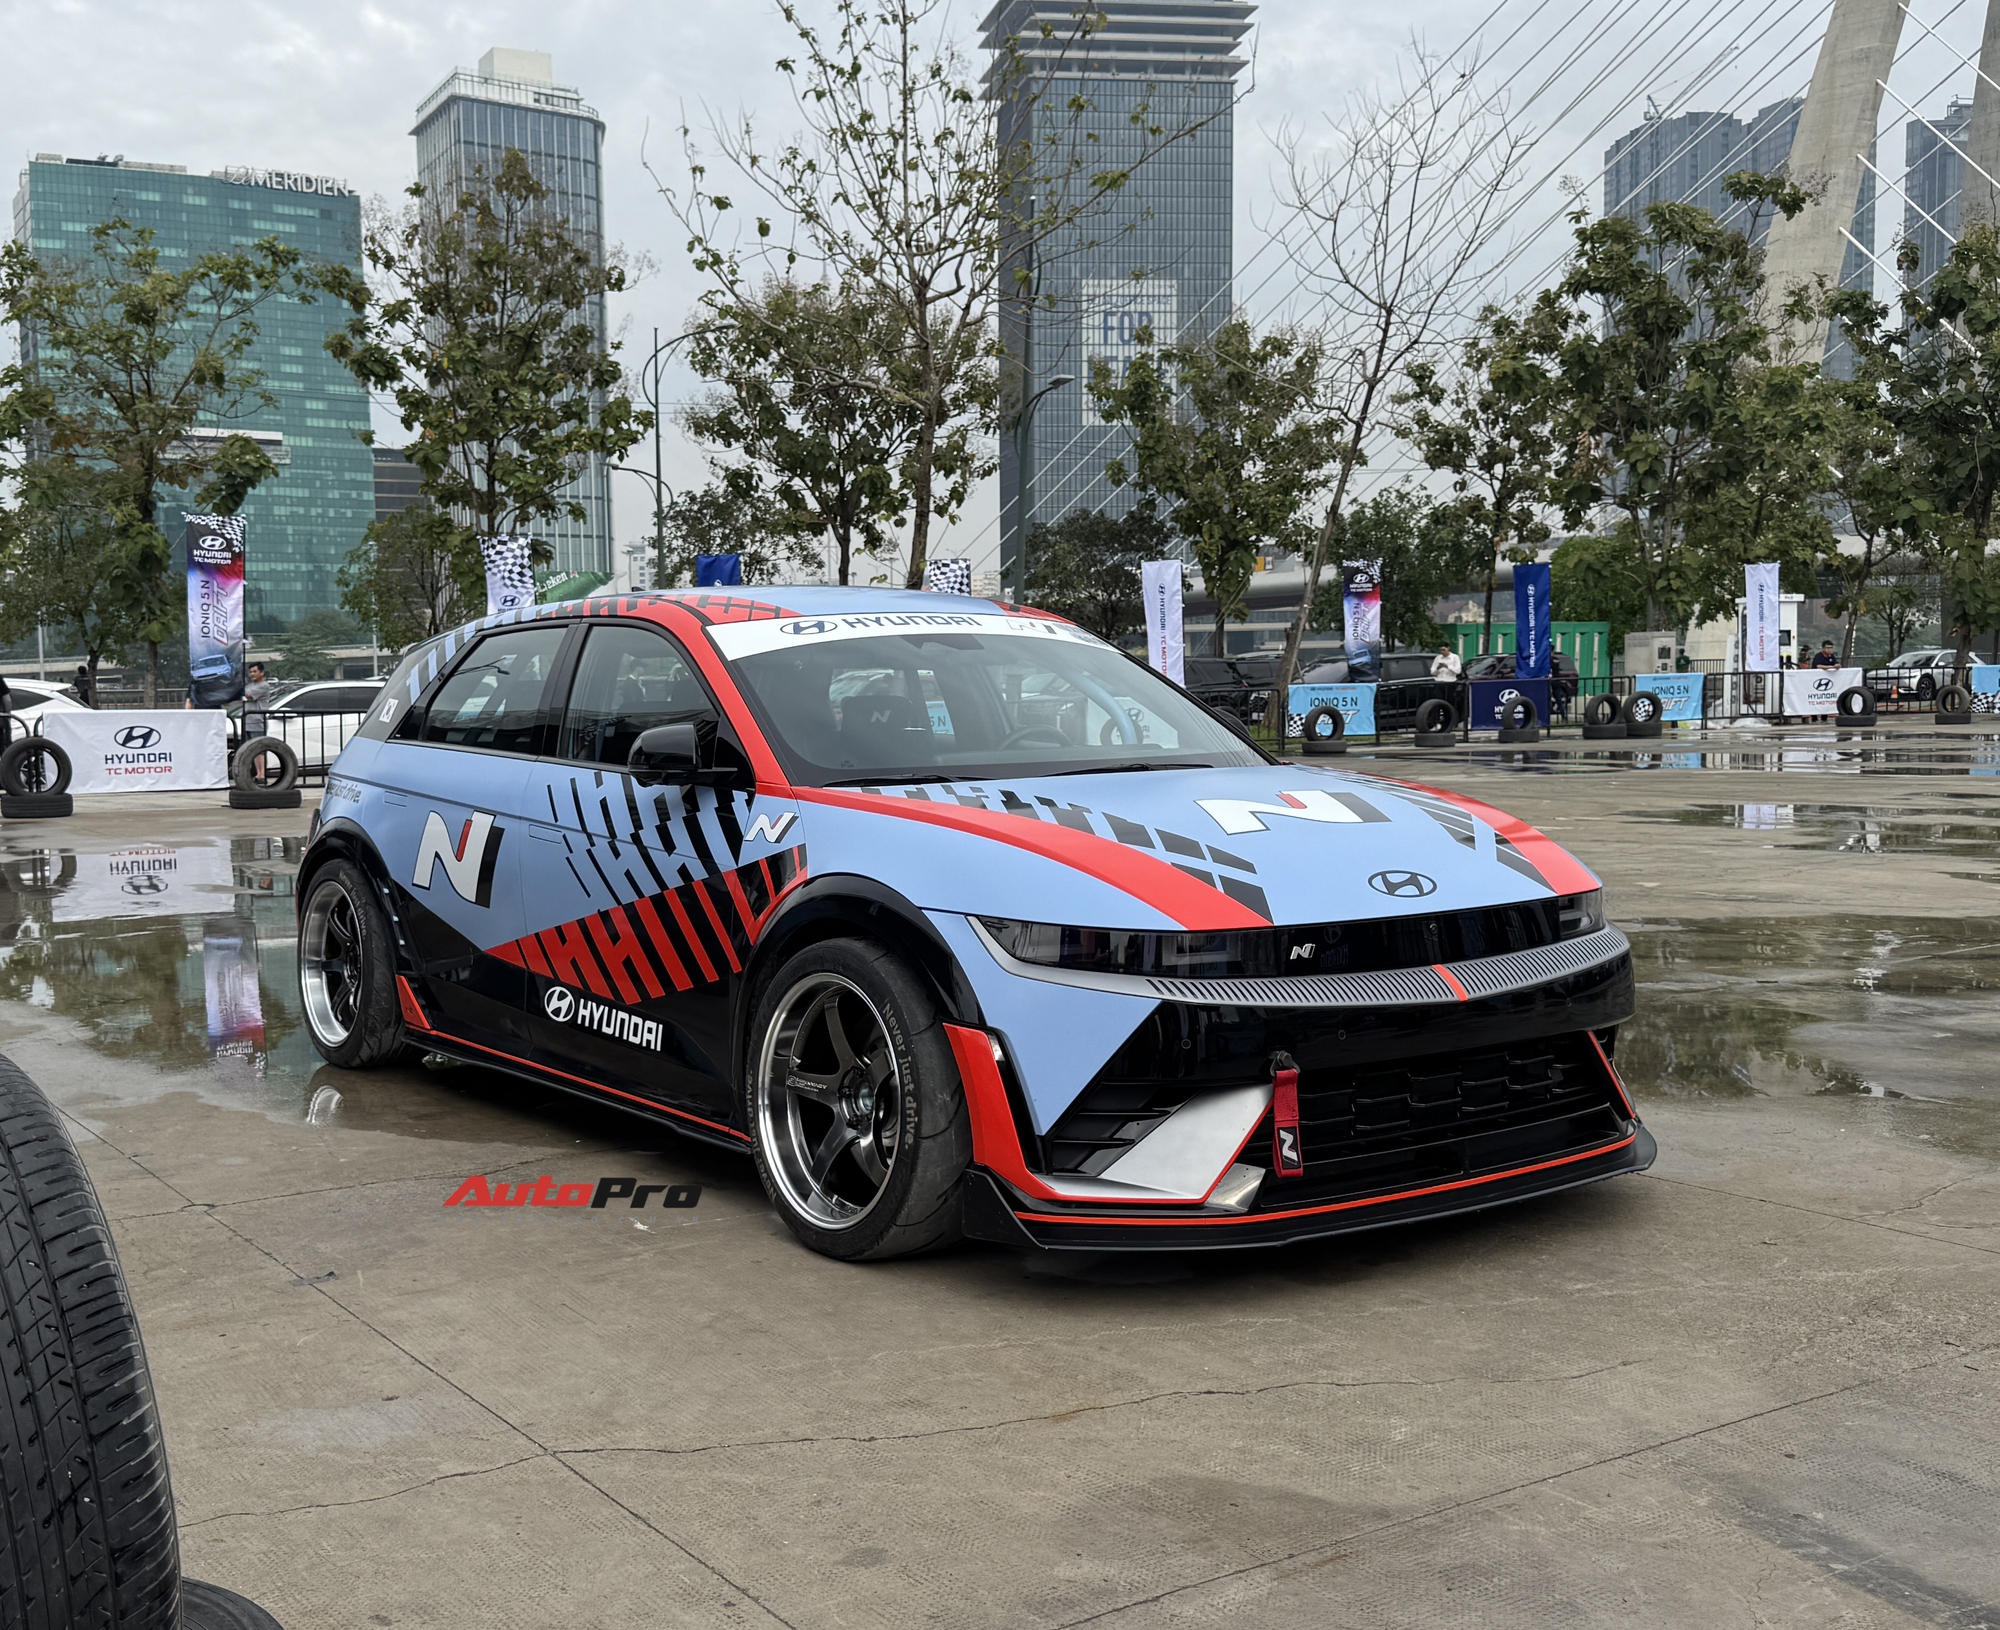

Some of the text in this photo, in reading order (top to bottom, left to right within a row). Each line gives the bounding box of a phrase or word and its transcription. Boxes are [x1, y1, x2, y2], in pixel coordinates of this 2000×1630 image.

[251, 170, 349, 197] MERIDIEN
[193, 549, 232, 559] HYUNDAI
[201, 591, 211, 600] 5
[201, 603, 211, 638] IONIQ
[846, 616, 983, 629] HYUNDAI
[1683, 685, 1689, 694] N
[1808, 692, 1837, 700] HYUNDAI
[1309, 697, 1358, 708] IONIQ 5 N
[937, 716, 946, 727] N
[104, 752, 173, 764] HYUNDAI
[105, 766, 173, 775] TC MOTOR
[412, 810, 505, 909] N
[577, 1000, 664, 1052] HYUNDAI
[882, 1003, 919, 1150] Never just drive.
